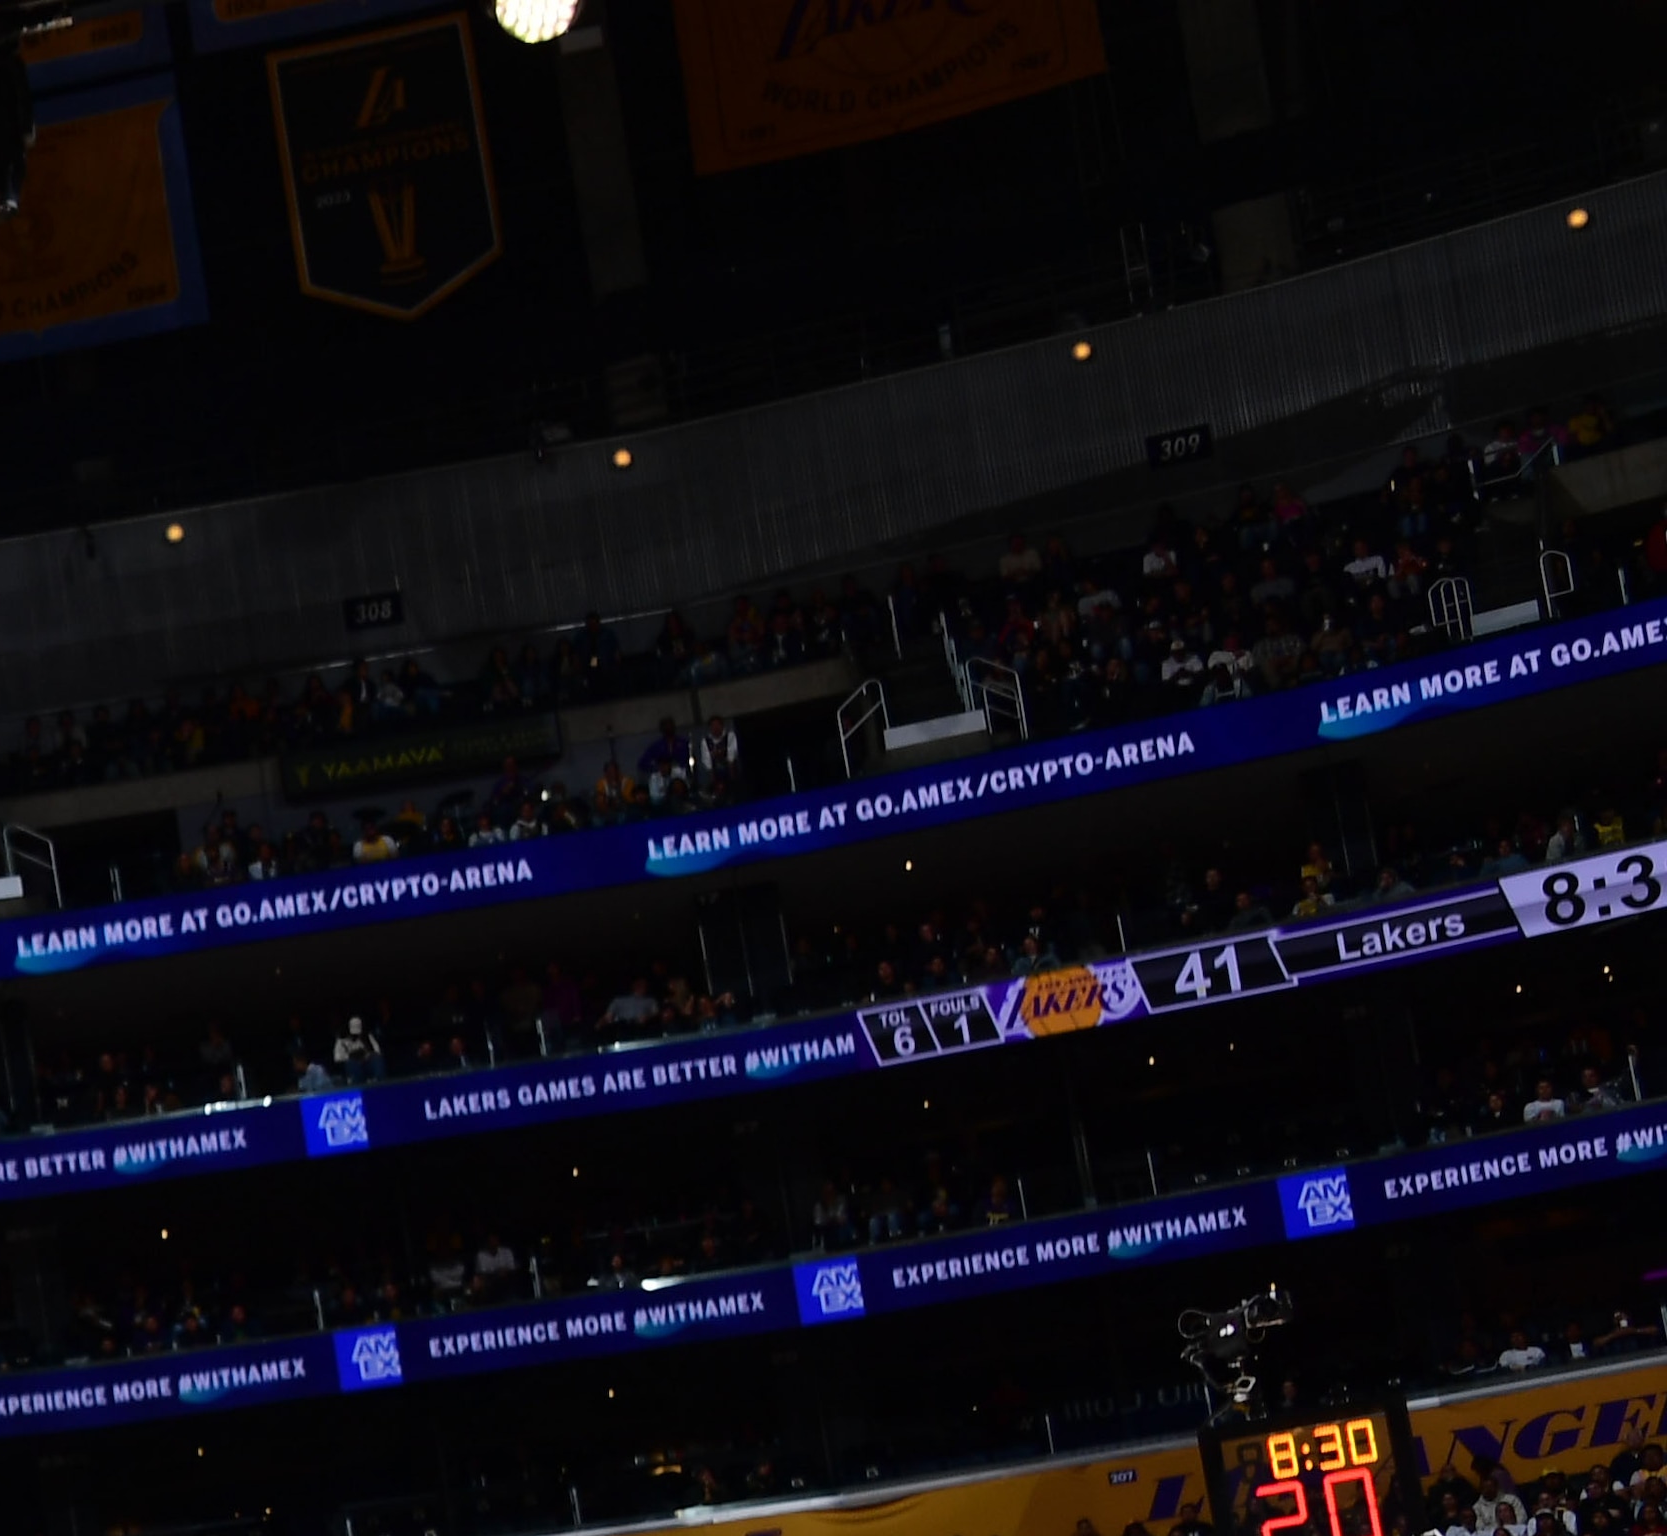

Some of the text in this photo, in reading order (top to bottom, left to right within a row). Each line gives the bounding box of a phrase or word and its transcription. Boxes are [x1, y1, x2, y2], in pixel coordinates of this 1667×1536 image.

[1160, 430, 1201, 460] 309
[353, 599, 394, 625] 308
[648, 731, 1197, 859] LEARN MORE AT GO.AMEX/CRYPTO-ARENA
[17, 859, 532, 957] LEARN MORE AT GO.AMEX/CRYPTO-ARENA
[1336, 912, 1466, 961] Lakers
[1175, 947, 1243, 998] 41
[878, 995, 981, 1026] TOL FOULS
[1005, 968, 1138, 1032] LAKERS
[893, 1018, 971, 1056] 6 1
[425, 1055, 736, 1119] LAKERS GAMES ARE BETTER
[25, 1150, 105, 1178] BETTER
[114, 1129, 246, 1166] #WITHAMEX
[1385, 1153, 1531, 1198] EXPERIENCE
[1539, 1137, 1607, 1168] MORE
[893, 1207, 1246, 1287] EXPERIENCE MORE #WITHAMEX
[113, 1377, 171, 1402] MORE
[179, 1358, 305, 1393] #WITHAMEX
[1267, 1419, 1378, 1480] 8:30
